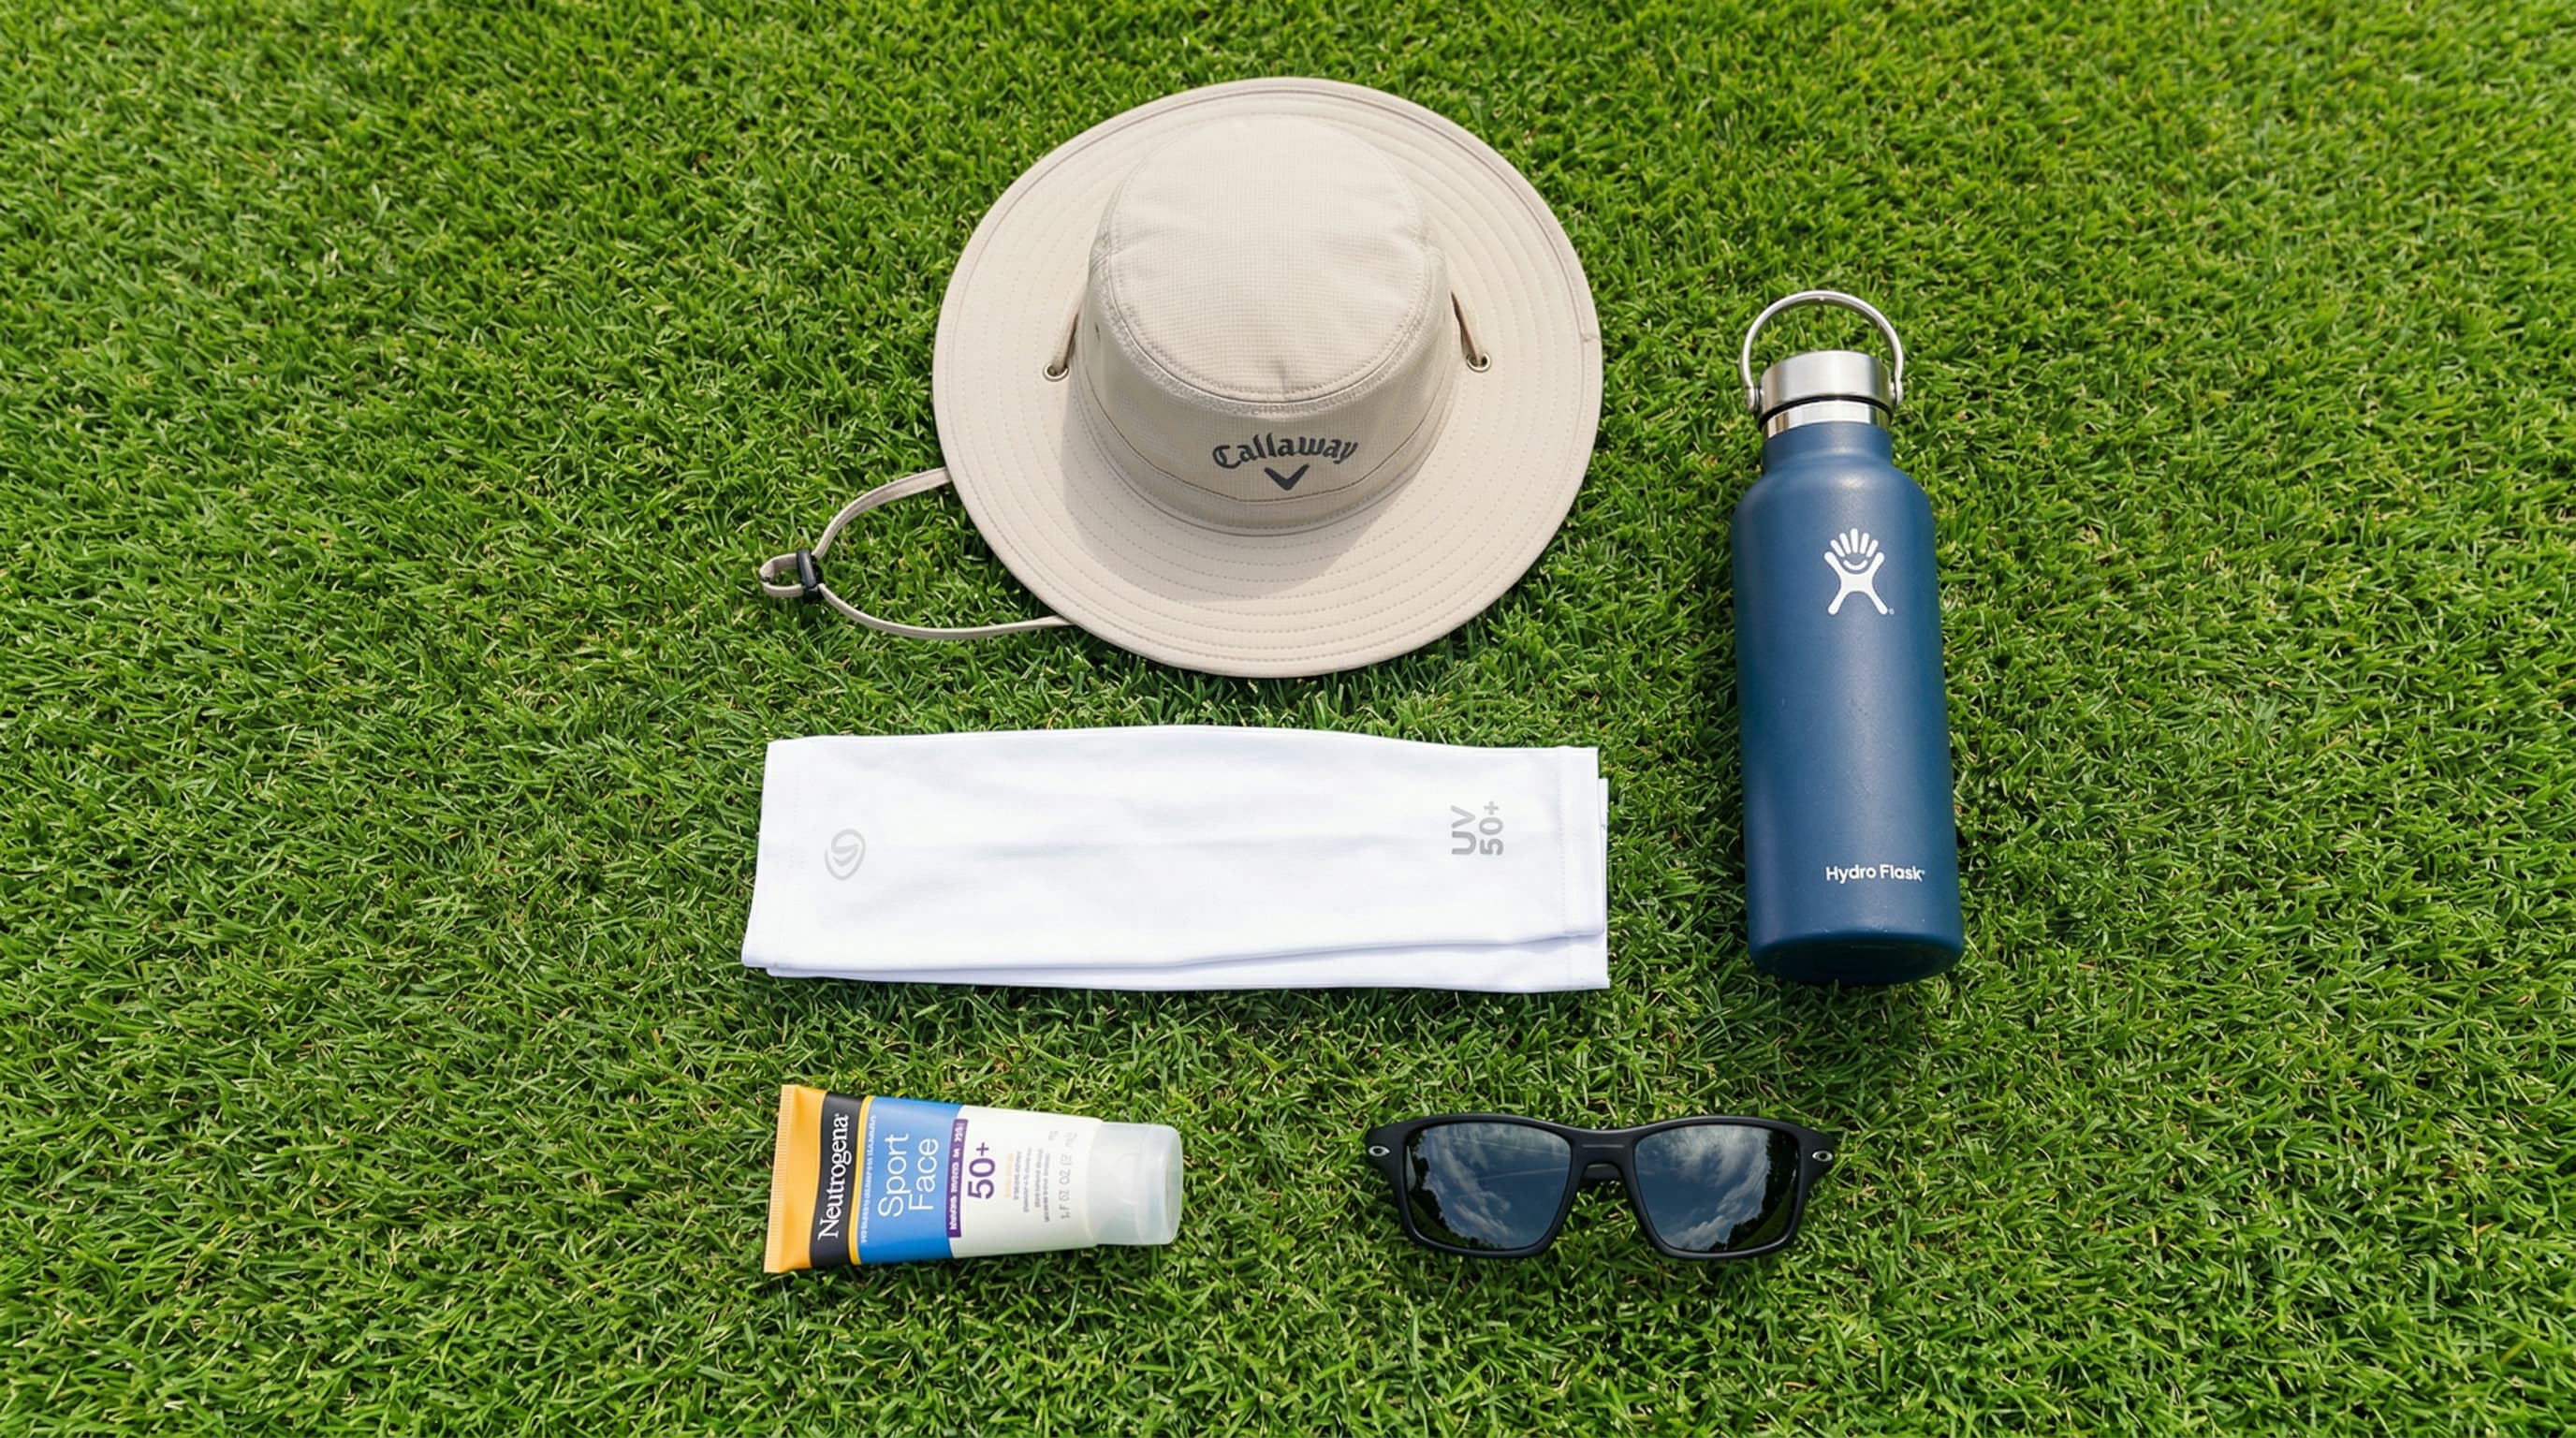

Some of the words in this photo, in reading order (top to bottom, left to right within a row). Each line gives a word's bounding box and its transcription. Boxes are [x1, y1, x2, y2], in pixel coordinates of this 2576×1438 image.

[1212, 433, 1358, 468] Callaway
[1451, 805, 1477, 855] UV
[1479, 800, 1503, 856] 50+
[1826, 865, 1876, 884] Hydro
[1880, 864, 1922, 882] Flask
[818, 1113, 850, 1240] Neutrogena
[878, 1133, 908, 1217] Sport
[909, 1138, 939, 1211] Face
[967, 1141, 996, 1200] 50+
